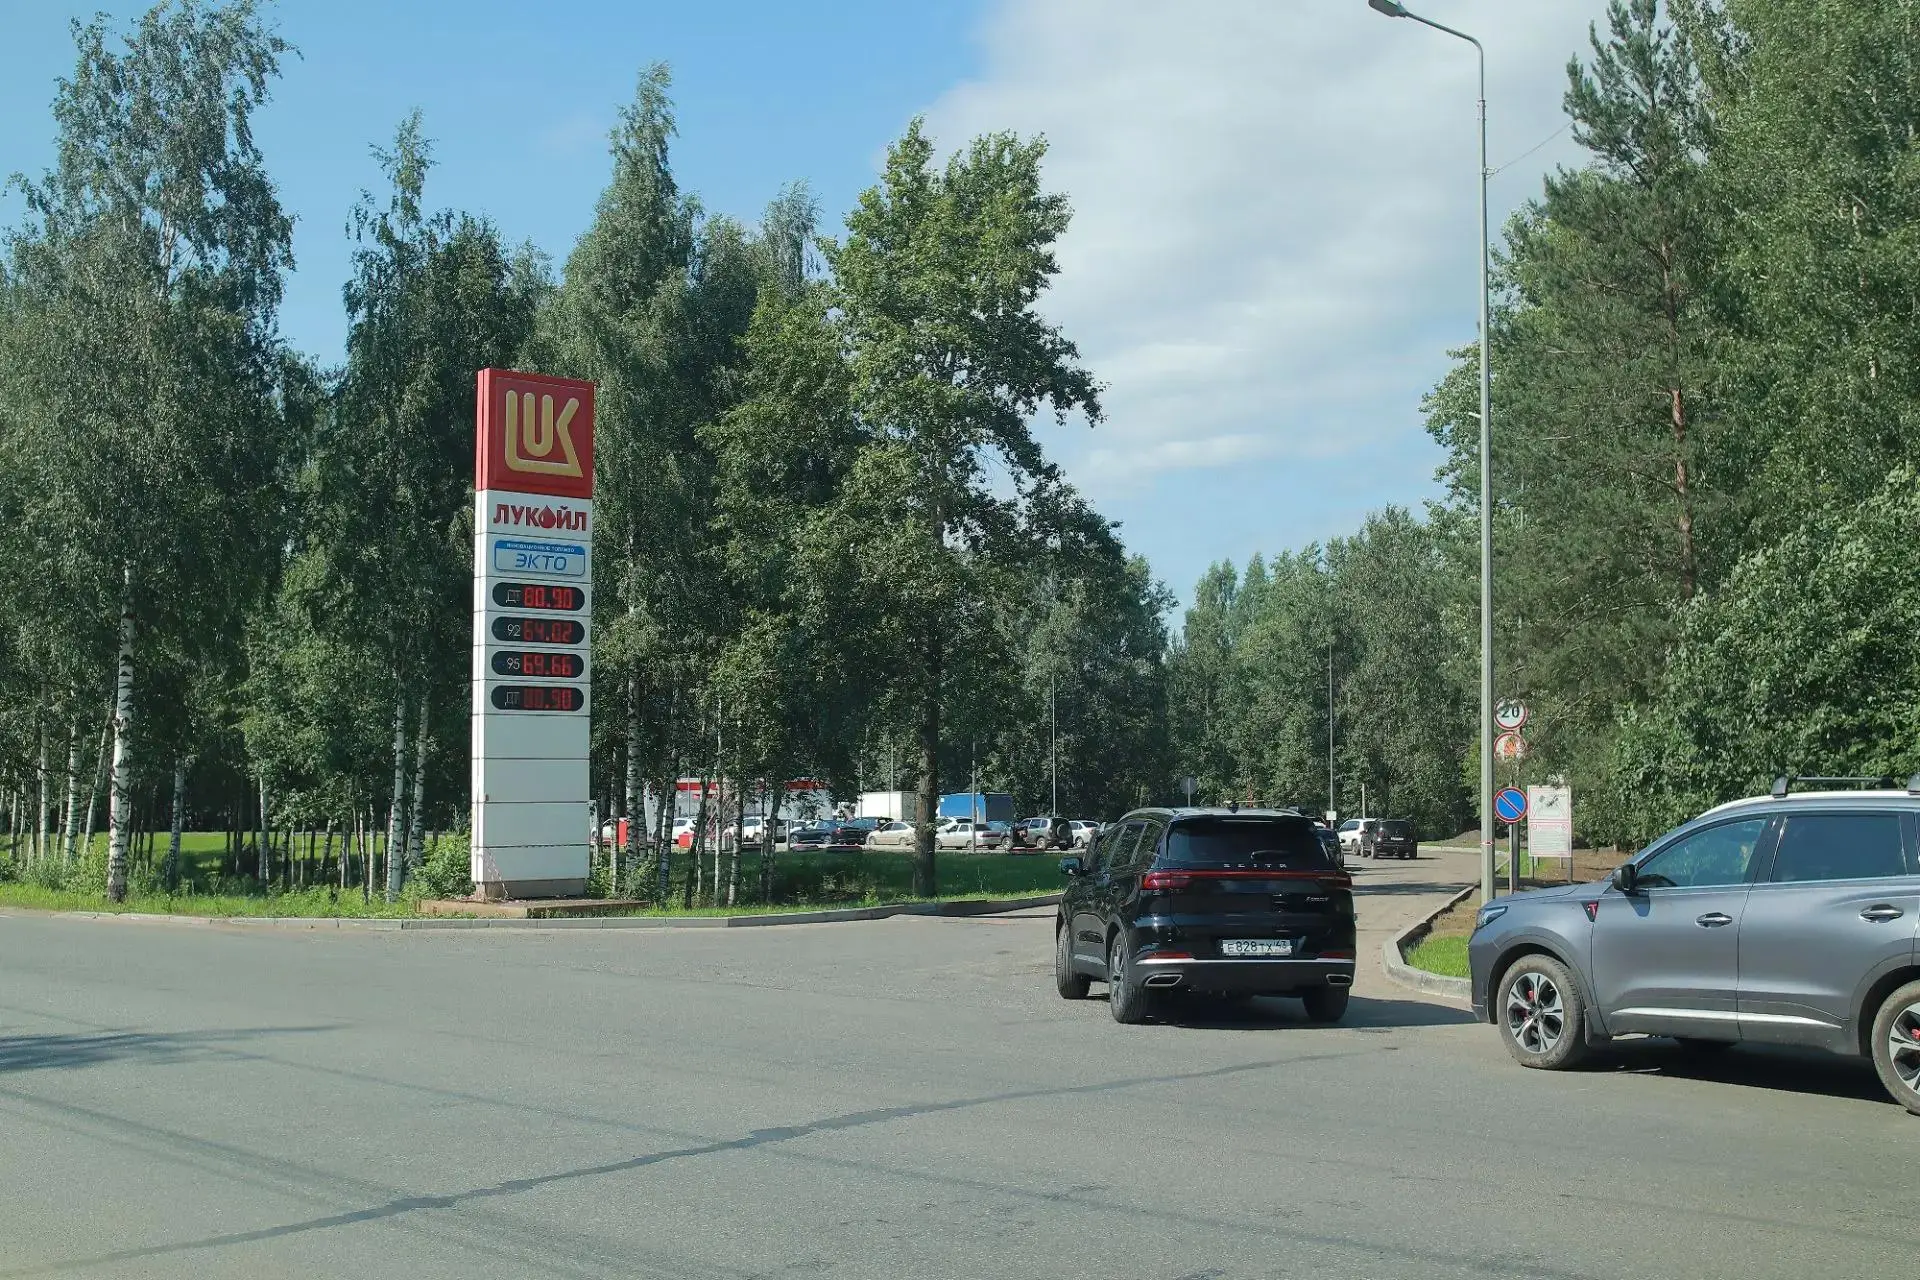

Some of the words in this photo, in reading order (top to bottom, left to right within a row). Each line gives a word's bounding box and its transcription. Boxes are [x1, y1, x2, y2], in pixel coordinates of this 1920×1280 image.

[515, 553, 567, 570] ЭКТО
[507, 623, 521, 637] 92
[523, 620, 573, 642] 64.02
[506, 657, 520, 670] 95
[523, 654, 573, 676] 69.66
[1500, 704, 1520, 718] 20
